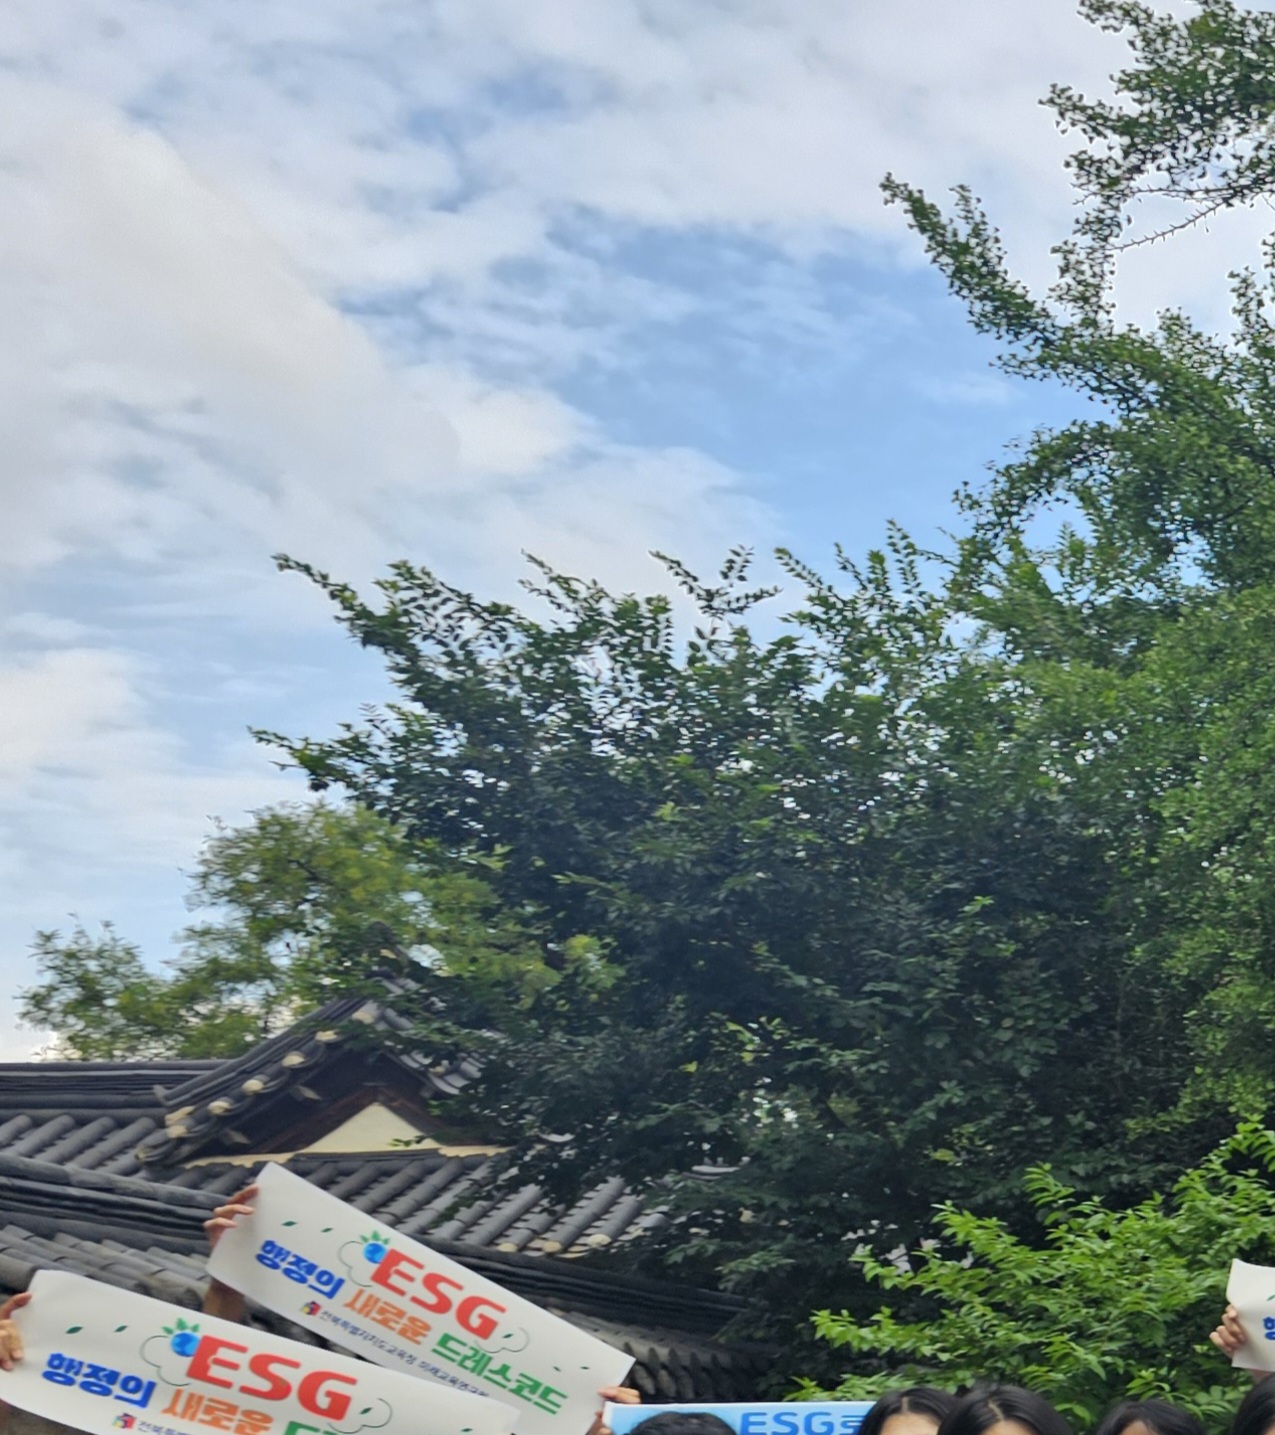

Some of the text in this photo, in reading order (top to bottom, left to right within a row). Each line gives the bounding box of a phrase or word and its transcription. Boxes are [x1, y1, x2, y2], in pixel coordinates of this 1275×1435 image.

[257, 1240, 568, 1416] 행정의 새로운 드레스코드
[372, 1250, 504, 1339] ESG
[42, 1353, 155, 1408] 행정의
[187, 1336, 356, 1421] ESG
